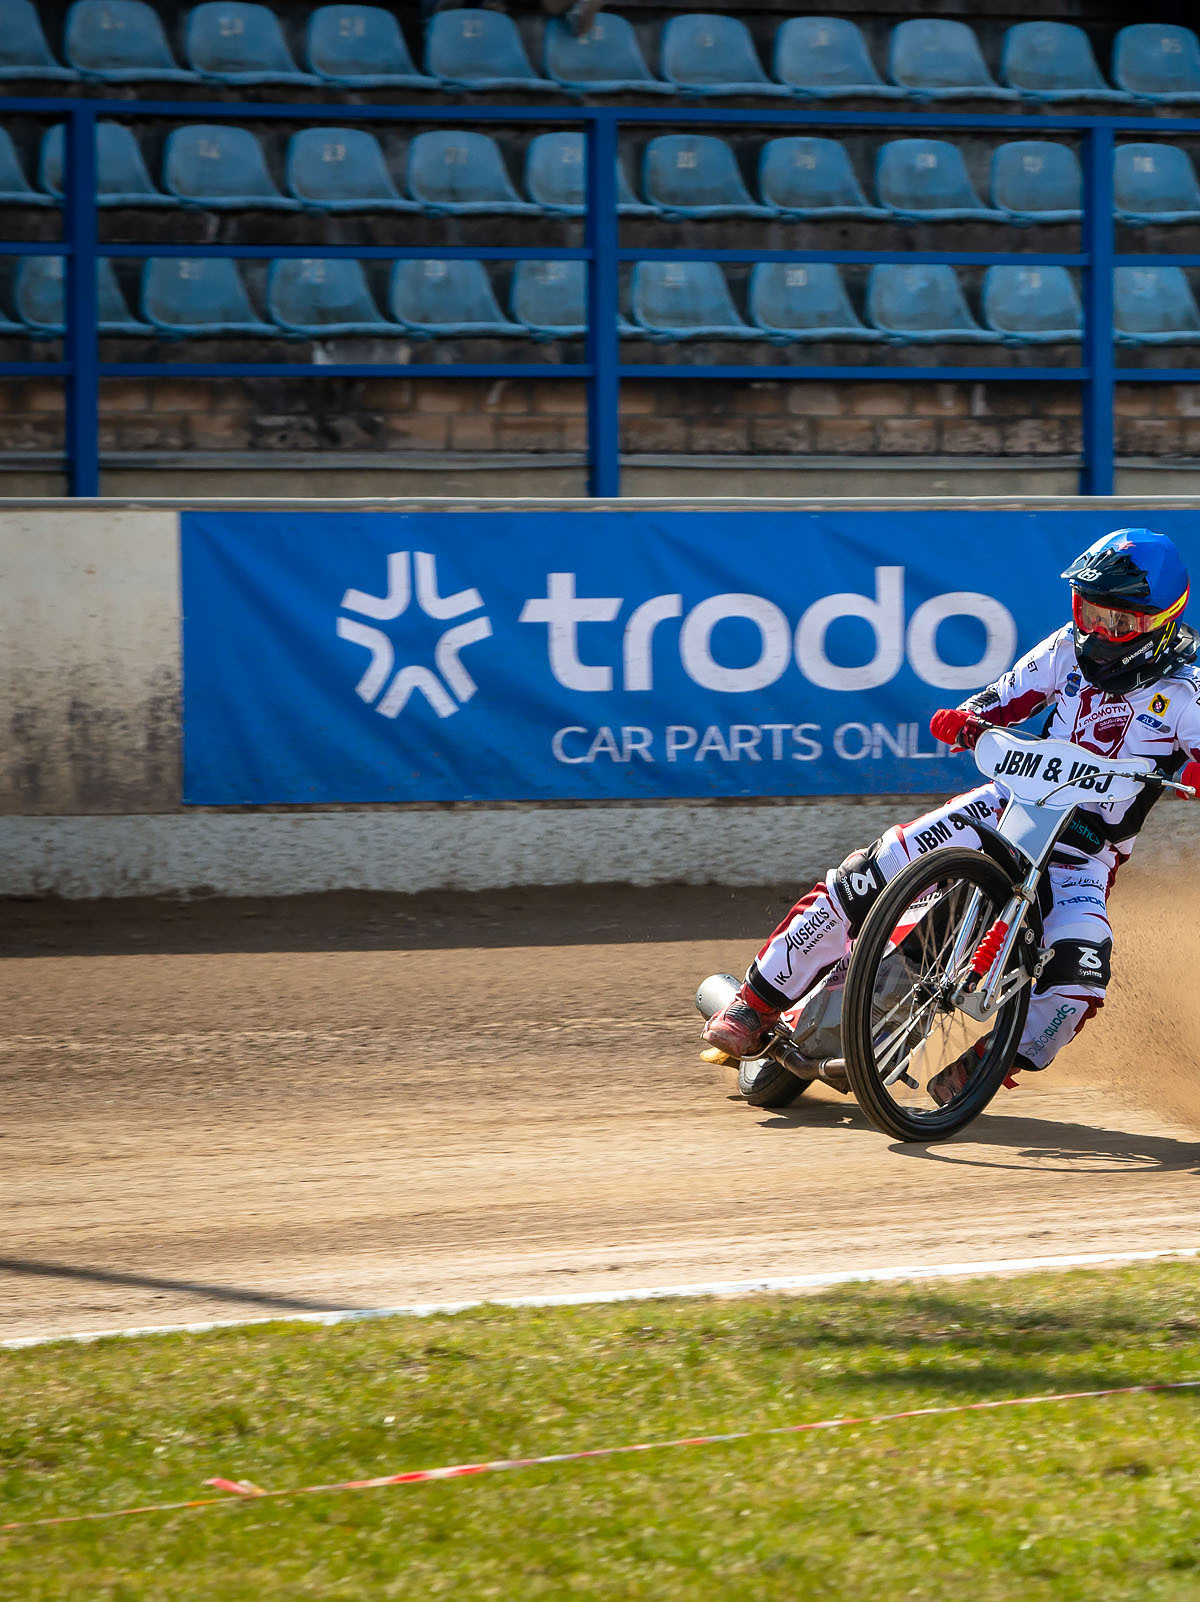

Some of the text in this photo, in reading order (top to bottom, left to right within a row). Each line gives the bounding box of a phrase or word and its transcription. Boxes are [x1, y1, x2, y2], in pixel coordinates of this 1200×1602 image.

[519, 566, 1018, 692] trodo
[551, 726, 654, 764] CAR
[665, 722, 823, 763] PARTS
[994, 749, 1116, 793] JBM & VBJ
[913, 820, 953, 855] JBM
[963, 800, 996, 821] VB
[840, 875, 854, 901] Systems
[784, 907, 830, 960] AUSEKLIS
[802, 919, 838, 955] ANNO 1981
[1079, 969, 1102, 978] Systems
